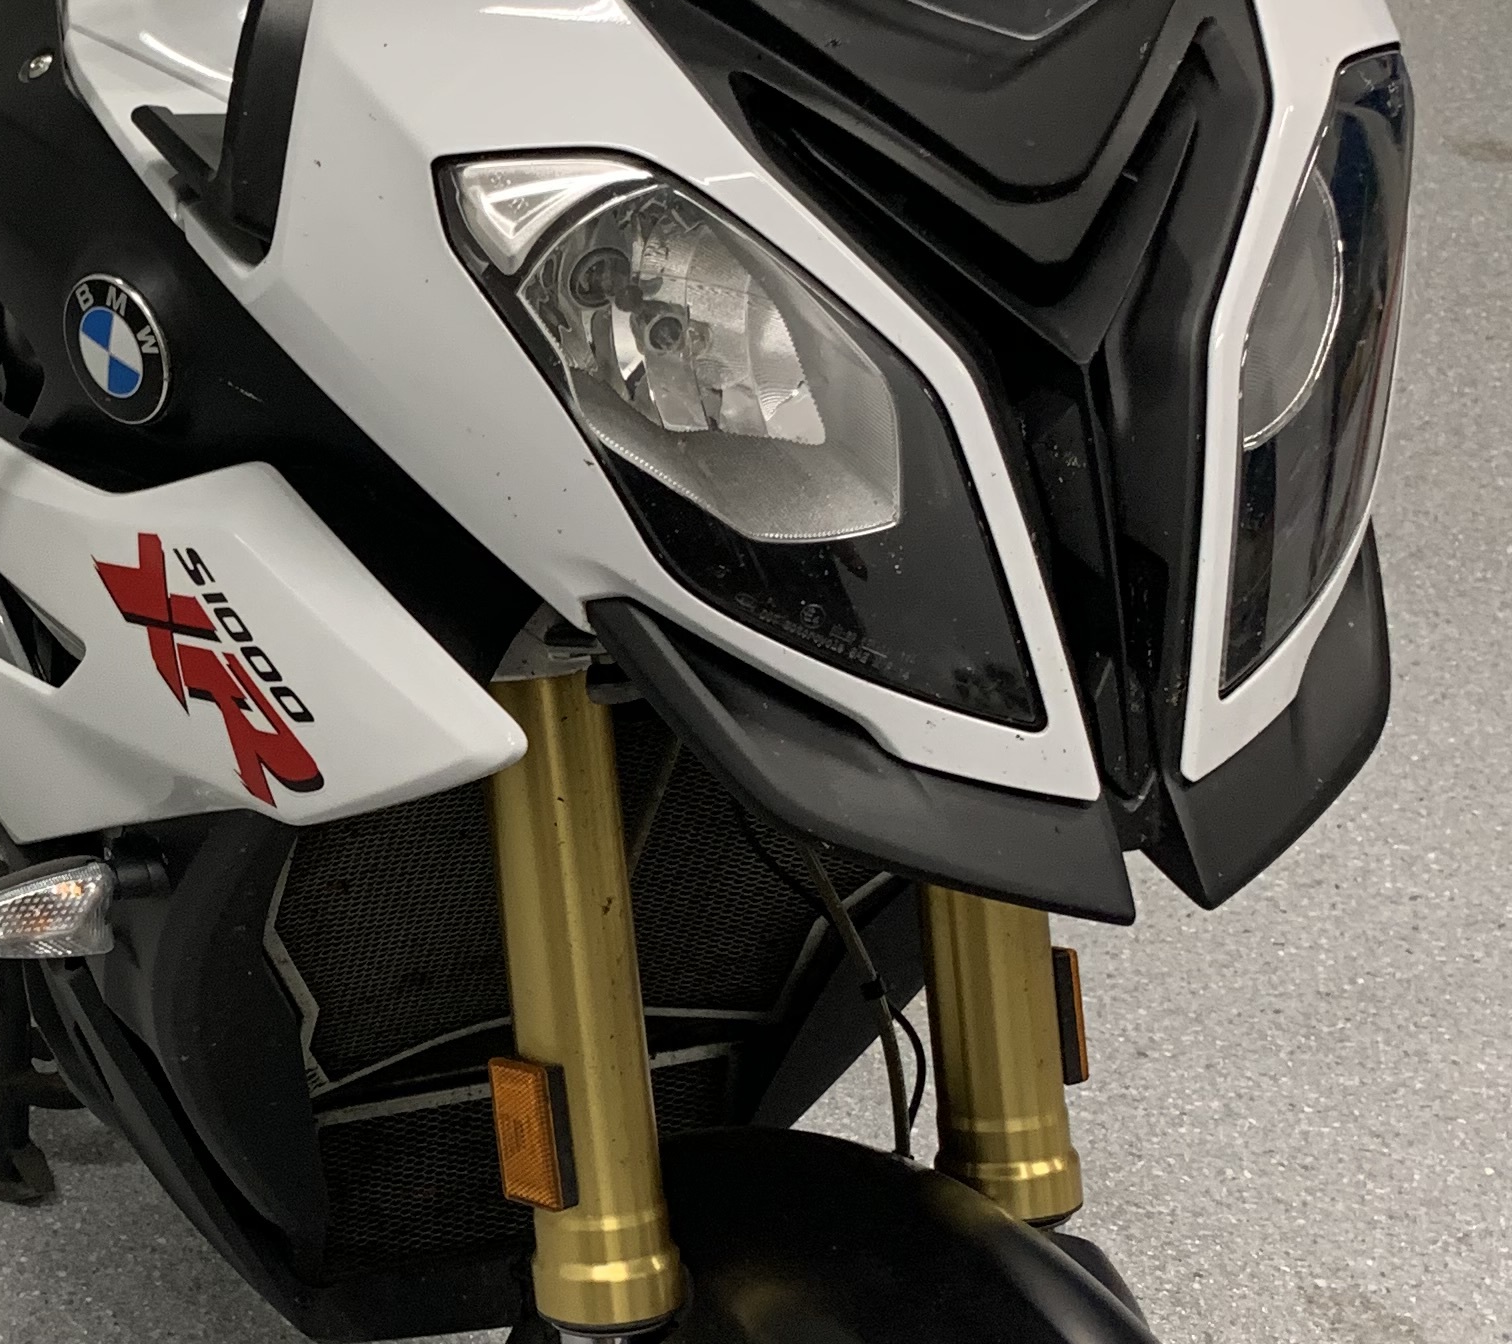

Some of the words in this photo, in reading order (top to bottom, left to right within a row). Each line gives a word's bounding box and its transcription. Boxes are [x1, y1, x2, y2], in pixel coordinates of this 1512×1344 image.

[75, 283, 160, 355] BMW
[90, 531, 325, 809] XR
[173, 547, 315, 723] S1000
